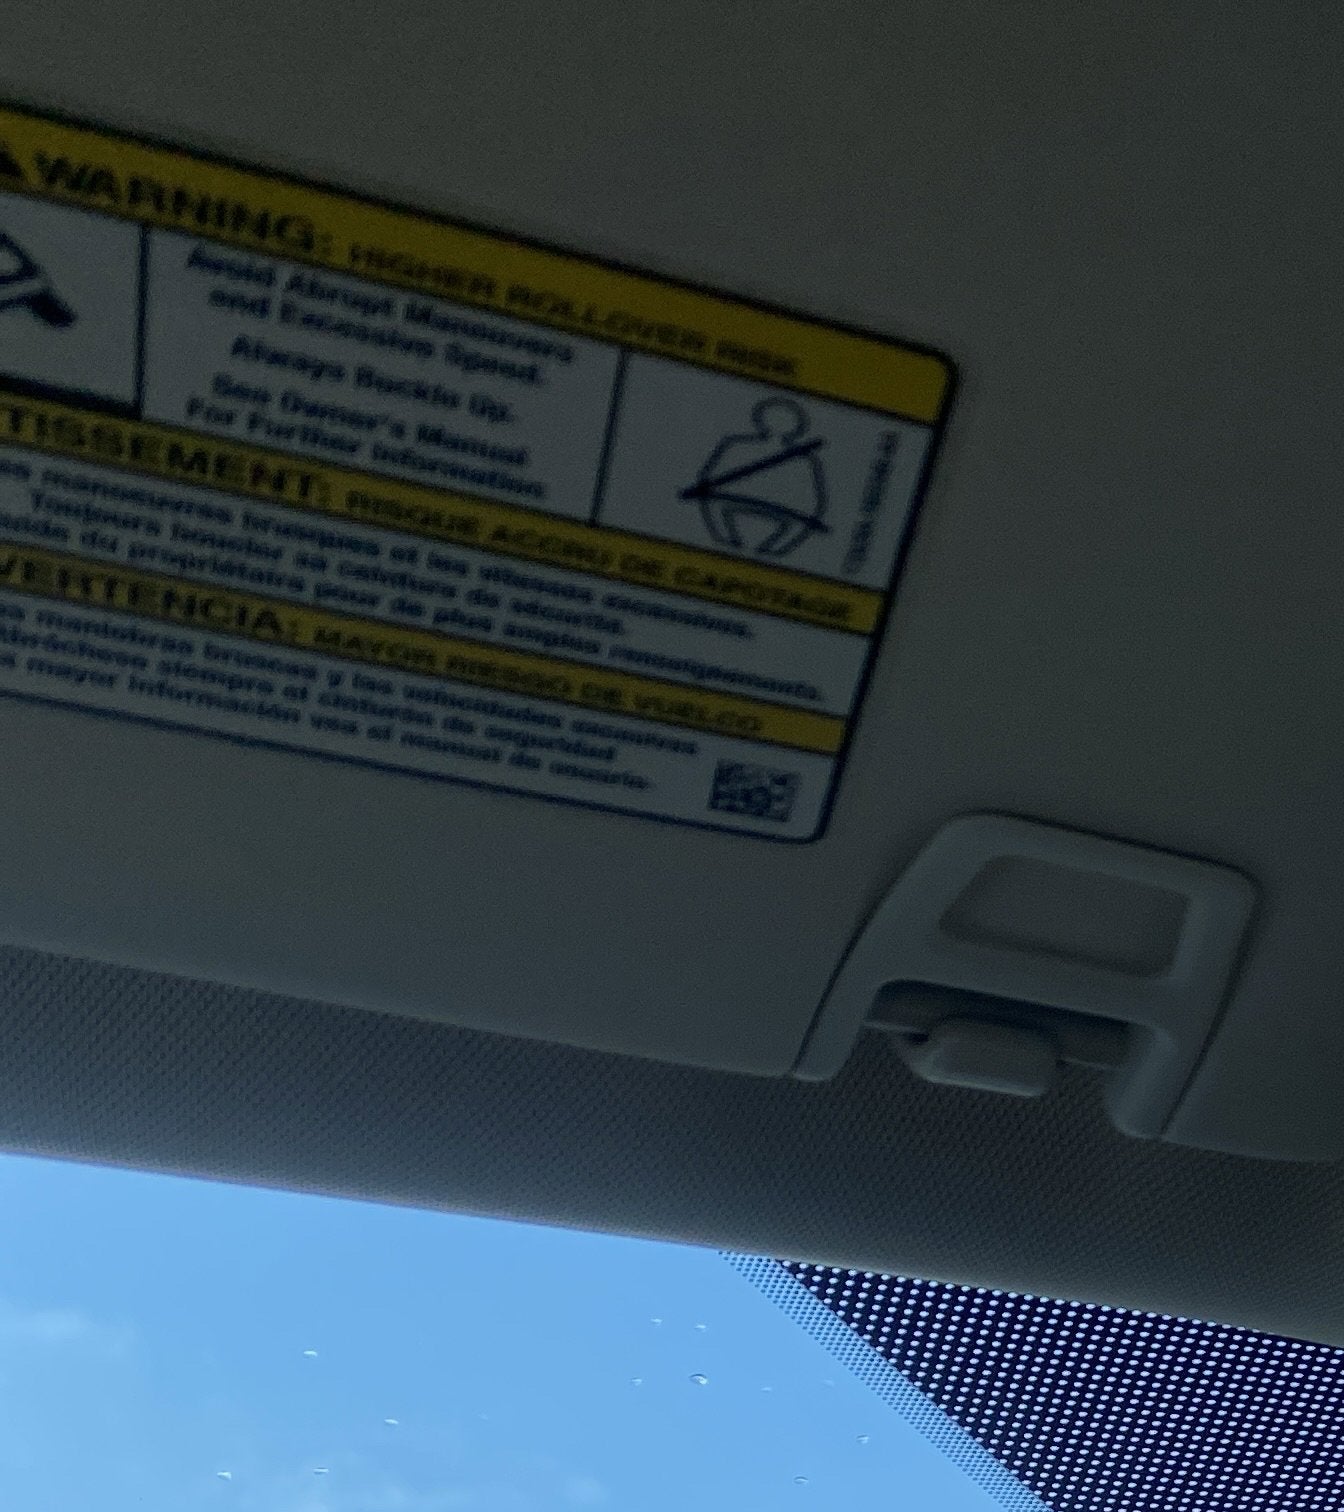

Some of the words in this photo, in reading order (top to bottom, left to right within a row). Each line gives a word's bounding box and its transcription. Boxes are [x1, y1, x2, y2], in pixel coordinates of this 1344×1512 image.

[34, 149, 334, 254] WARNING:
[347, 243, 498, 300] HIGHER
[503, 283, 707, 354] ROLLOVER
[713, 338, 798, 377] RISK
[187, 245, 279, 287] Avoid
[283, 270, 397, 321] Abrupt
[206, 284, 271, 318] and
[276, 301, 436, 359] Excessive
[230, 332, 347, 383] Always
[353, 363, 463, 411] Buckle
[184, 394, 238, 427] For
[245, 409, 361, 456] Further
[211, 371, 274, 406] See
[277, 387, 408, 439] Owner's
[414, 420, 530, 467] Manual
[344, 489, 481, 537] RISQUE
[490, 522, 614, 568] ACCRU
[617, 551, 666, 579] DE
[672, 564, 853, 621] CAPOTAGE
[312, 625, 438, 667] MAYOR
[444, 654, 572, 697] RIESGO
[577, 682, 622, 706] DE
[632, 691, 764, 733] VUELCO
